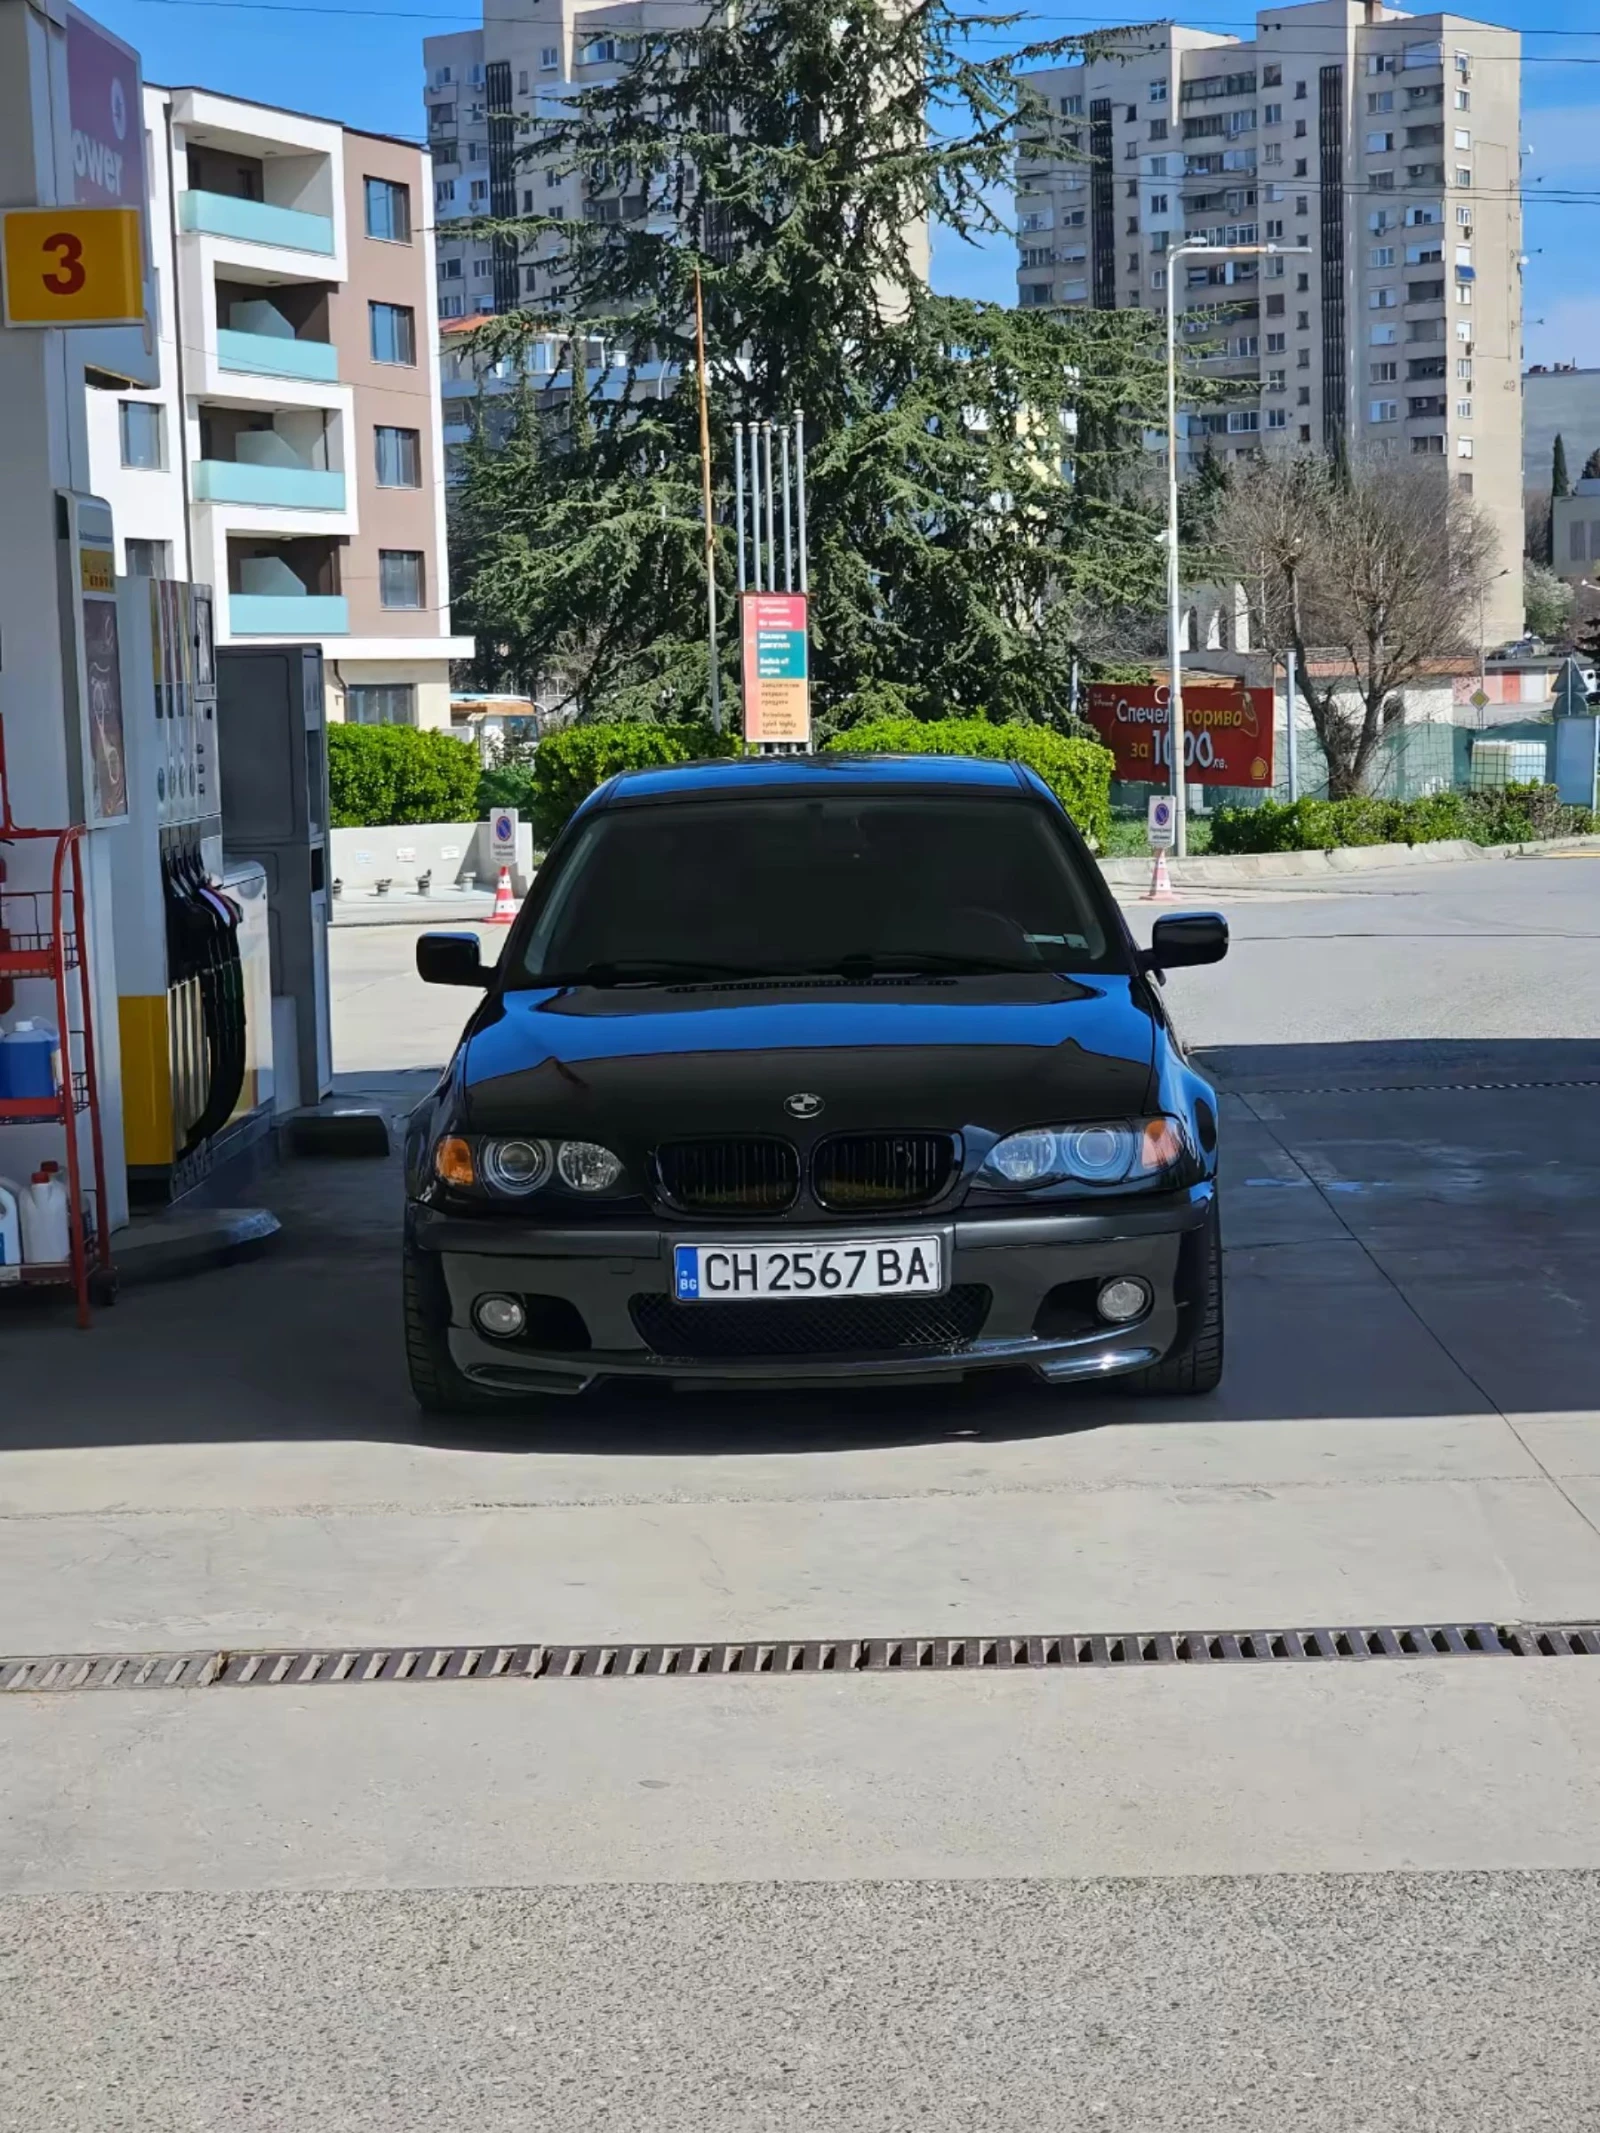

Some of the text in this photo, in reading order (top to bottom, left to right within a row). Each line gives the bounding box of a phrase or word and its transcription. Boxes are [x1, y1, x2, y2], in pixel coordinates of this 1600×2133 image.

[72, 129, 122, 196] ower
[42, 232, 86, 295] 3
[1116, 699, 1243, 729] Спечел гориво
[1130, 742, 1149, 758] за
[680, 1279, 698, 1291] BG
[705, 1246, 930, 1291] CH 2567 BA
